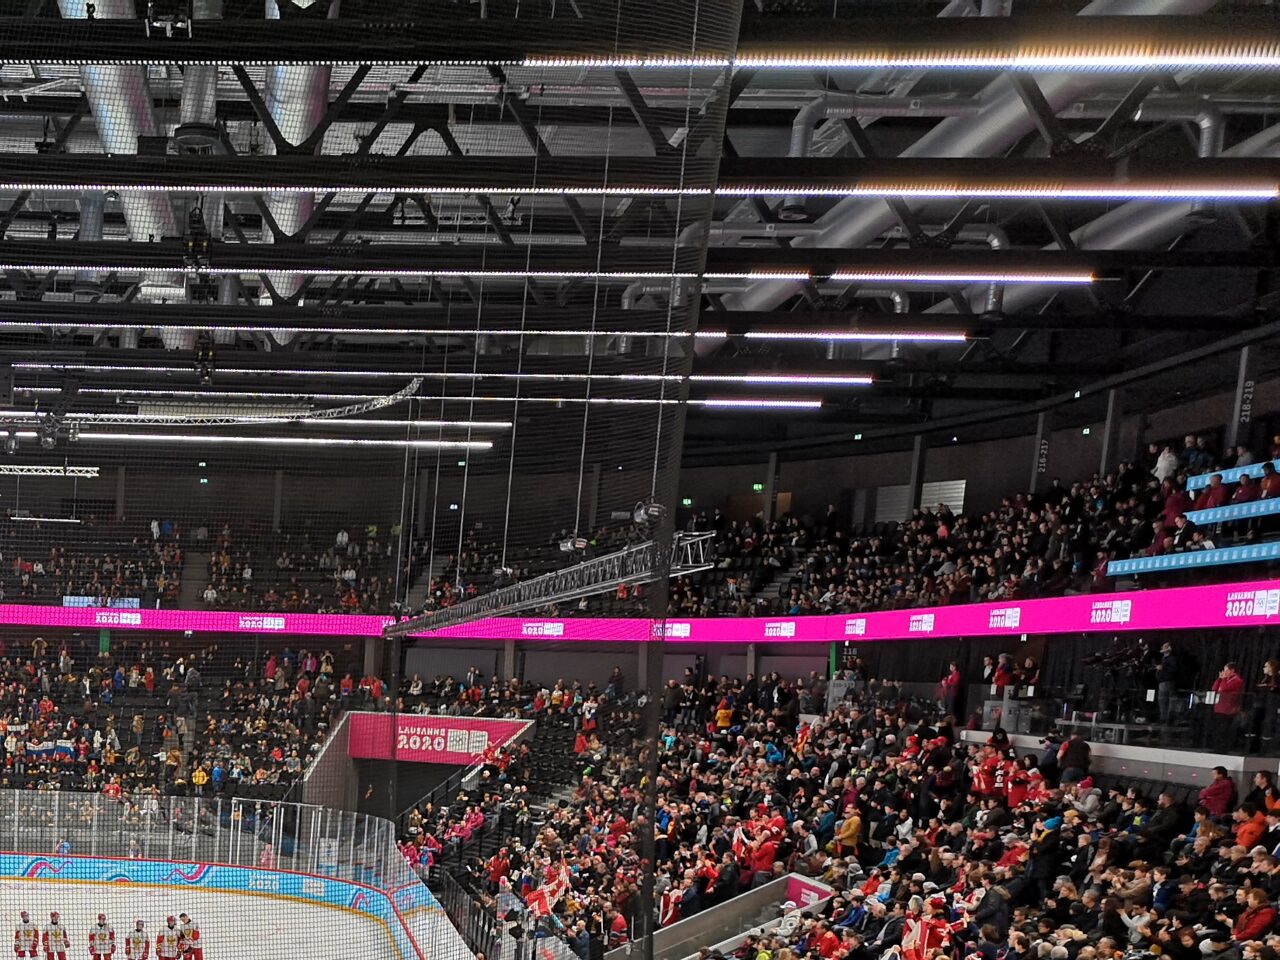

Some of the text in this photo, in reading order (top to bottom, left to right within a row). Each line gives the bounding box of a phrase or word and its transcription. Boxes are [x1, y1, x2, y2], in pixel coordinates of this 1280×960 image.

[1240, 381, 1254, 423] 218-219
[1038, 439, 1048, 473] 216-217
[1091, 609, 1111, 623] 2020
[1225, 601, 1254, 617] 2020
[398, 726, 445, 736] LAUSANNE
[397, 735, 445, 751] 2020
